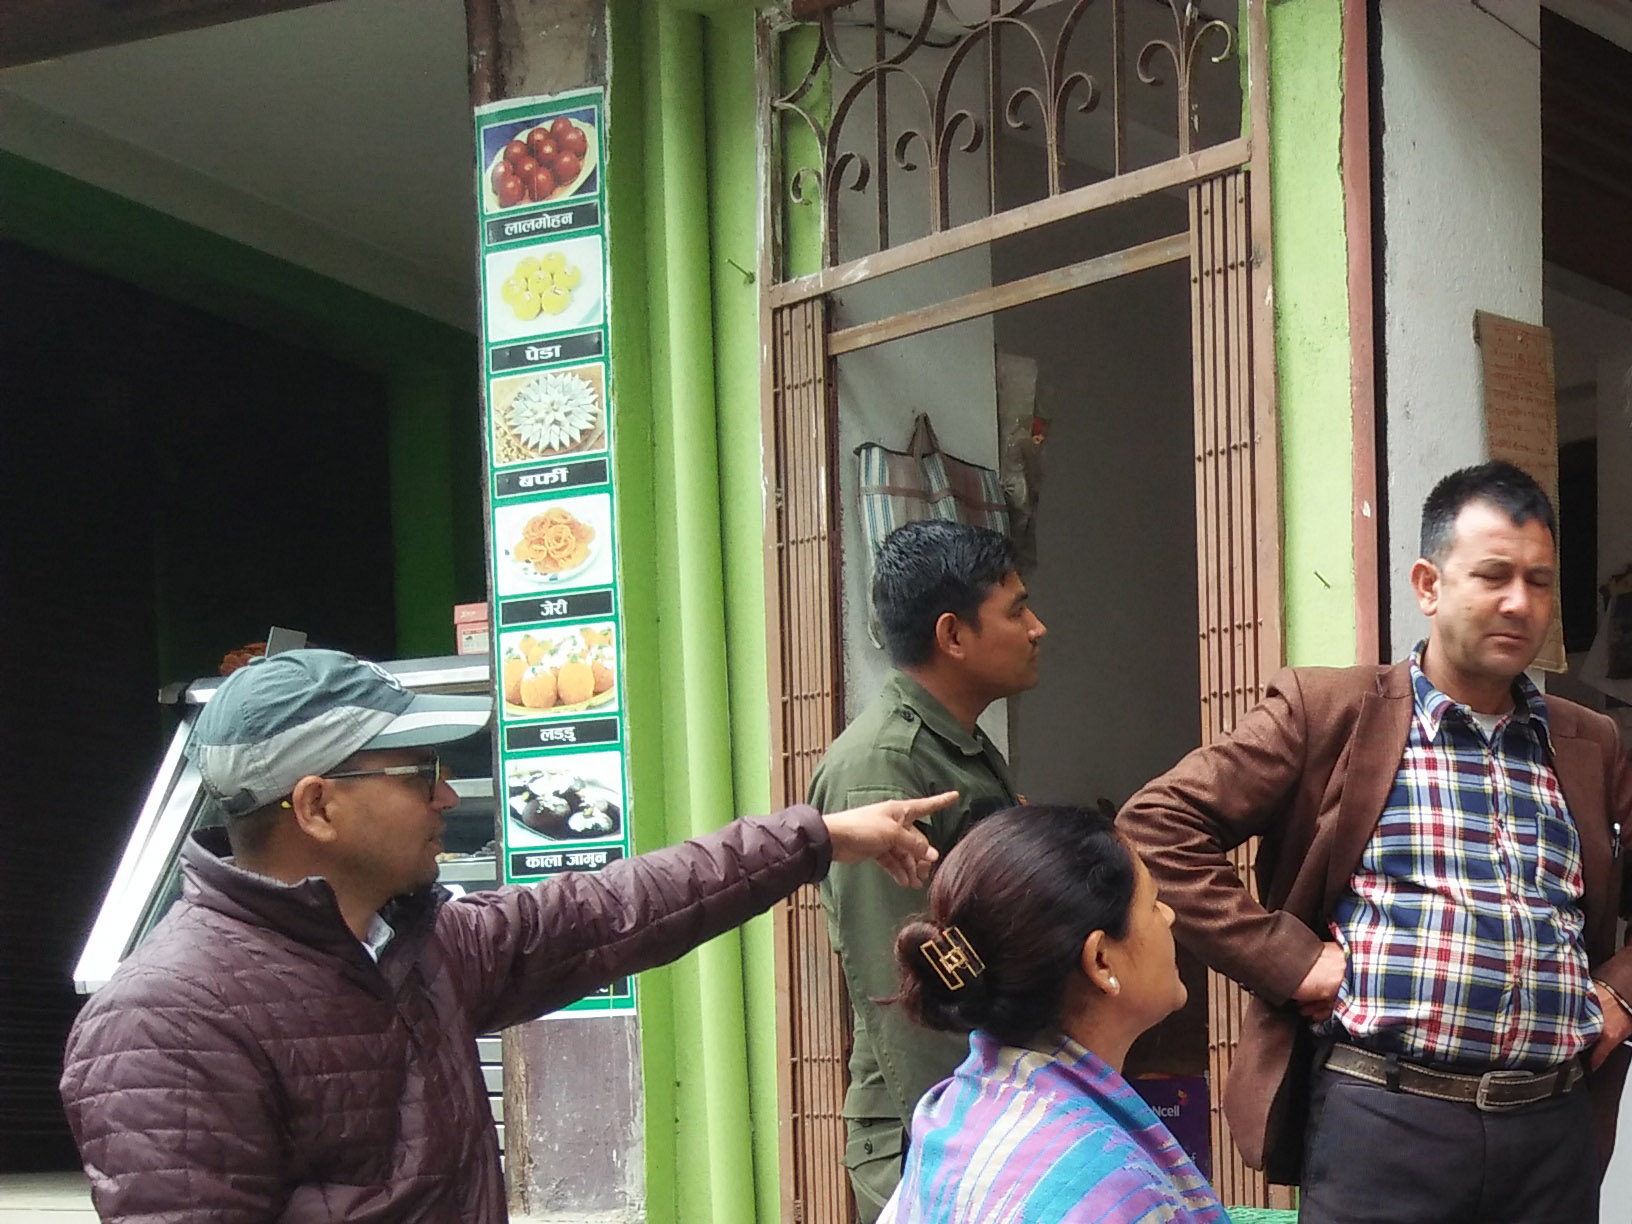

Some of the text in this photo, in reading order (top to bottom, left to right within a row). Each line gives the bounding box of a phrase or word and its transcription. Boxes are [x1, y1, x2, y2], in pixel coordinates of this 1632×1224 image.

[504, 211, 573, 236] लालमोहन
[525, 344, 562, 361] पेडा
[540, 599, 568, 617] जेरी
[525, 852, 607, 870] काला जामुन
[1152, 1105, 1180, 1118] Ncell
